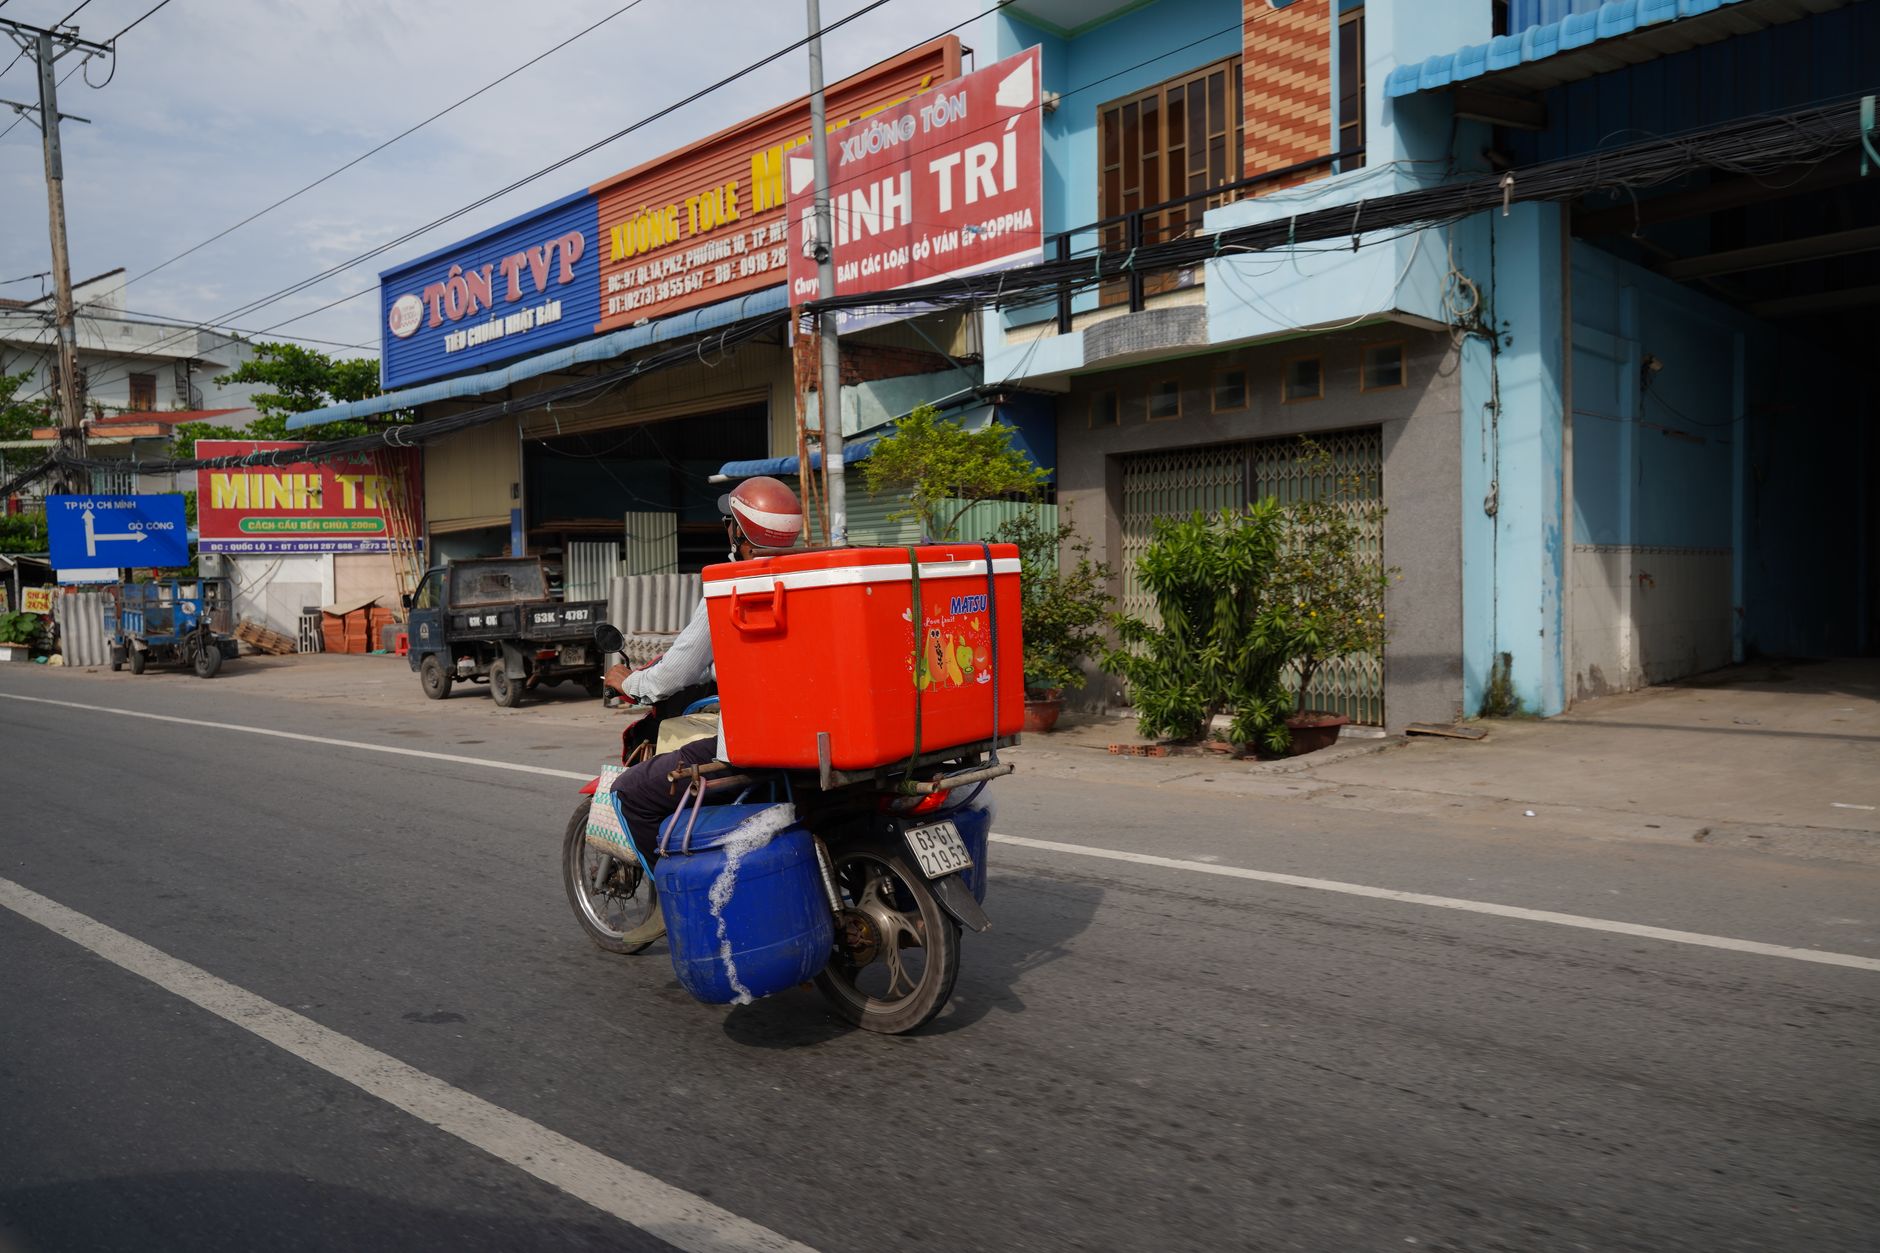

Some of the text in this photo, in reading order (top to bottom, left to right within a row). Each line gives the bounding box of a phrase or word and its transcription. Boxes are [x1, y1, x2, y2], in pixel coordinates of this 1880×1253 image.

[920, 90, 966, 134] TÔN
[929, 114, 1023, 214] TRÍ
[685, 181, 741, 237] TOLE
[740, 252, 769, 277] 0918
[771, 245, 788, 269] 28
[795, 277, 819, 296] Chuy
[837, 260, 859, 284] BÁN
[861, 253, 881, 277] CÁC
[932, 230, 958, 256] VÁN
[422, 231, 586, 329] TÔN TVP
[64, 501, 78, 510] TP
[210, 473, 323, 510] MINH
[146, 521, 174, 530] CÔNG
[534, 612, 555, 623] 63K
[565, 609, 588, 620] 4787
[950, 593, 988, 615] MATSU
[921, 844, 969, 875] 219.53
